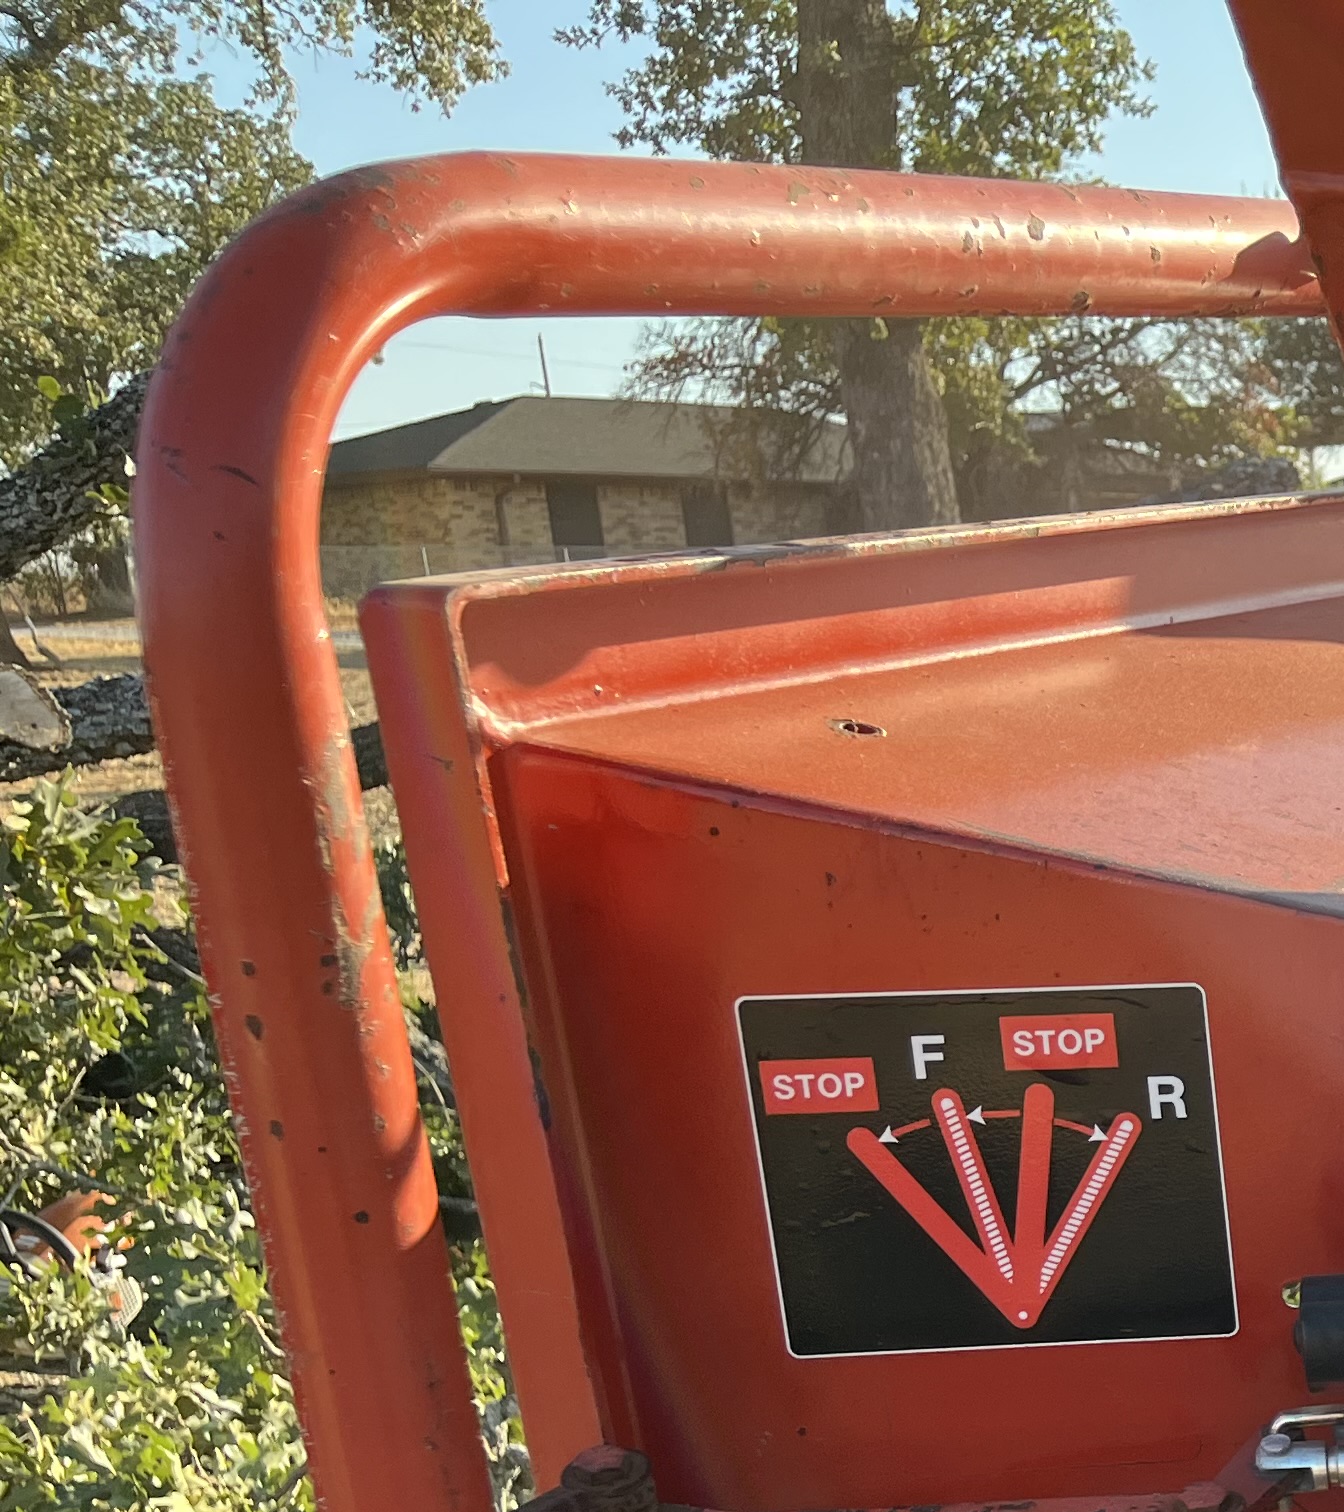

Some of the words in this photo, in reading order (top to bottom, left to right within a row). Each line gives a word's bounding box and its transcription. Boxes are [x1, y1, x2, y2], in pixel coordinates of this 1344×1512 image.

[910, 1034, 946, 1080] F
[1012, 1028, 1106, 1057] STOP
[773, 1071, 865, 1101] STOP
[1146, 1075, 1188, 1120] R
